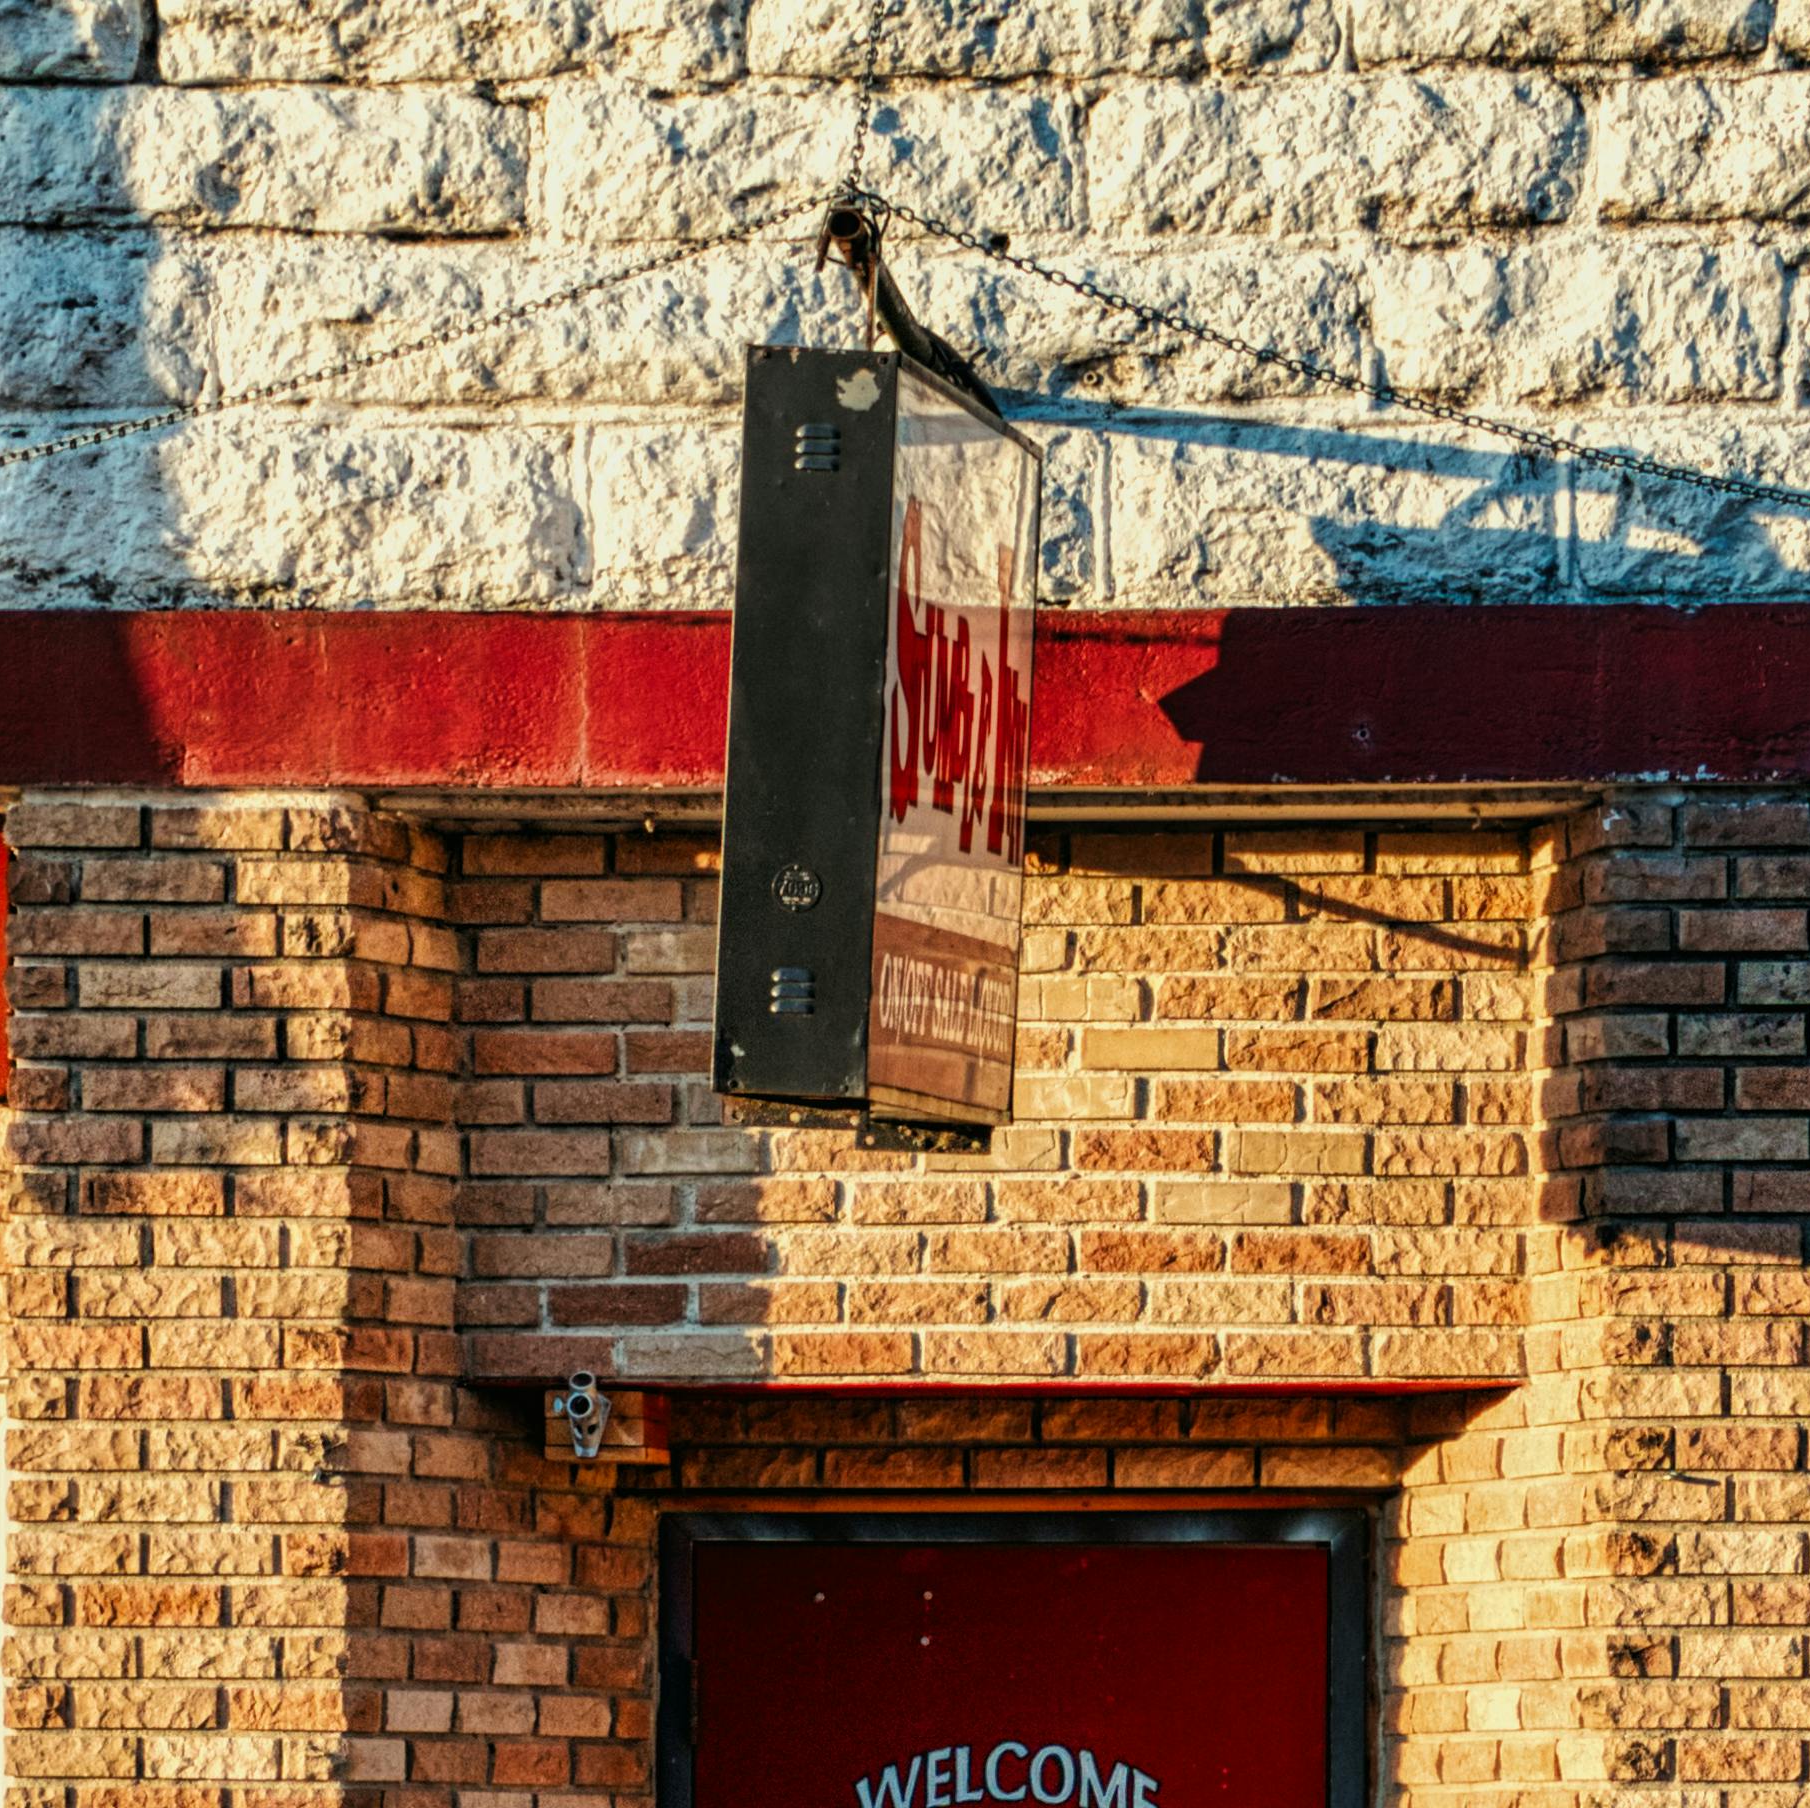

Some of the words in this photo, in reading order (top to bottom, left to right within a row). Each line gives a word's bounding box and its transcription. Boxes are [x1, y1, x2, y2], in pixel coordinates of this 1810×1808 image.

[889, 494, 993, 854] STUMBLE
[879, 953, 933, 1044] ON/OFF
[932, 966, 968, 1044] SALE
